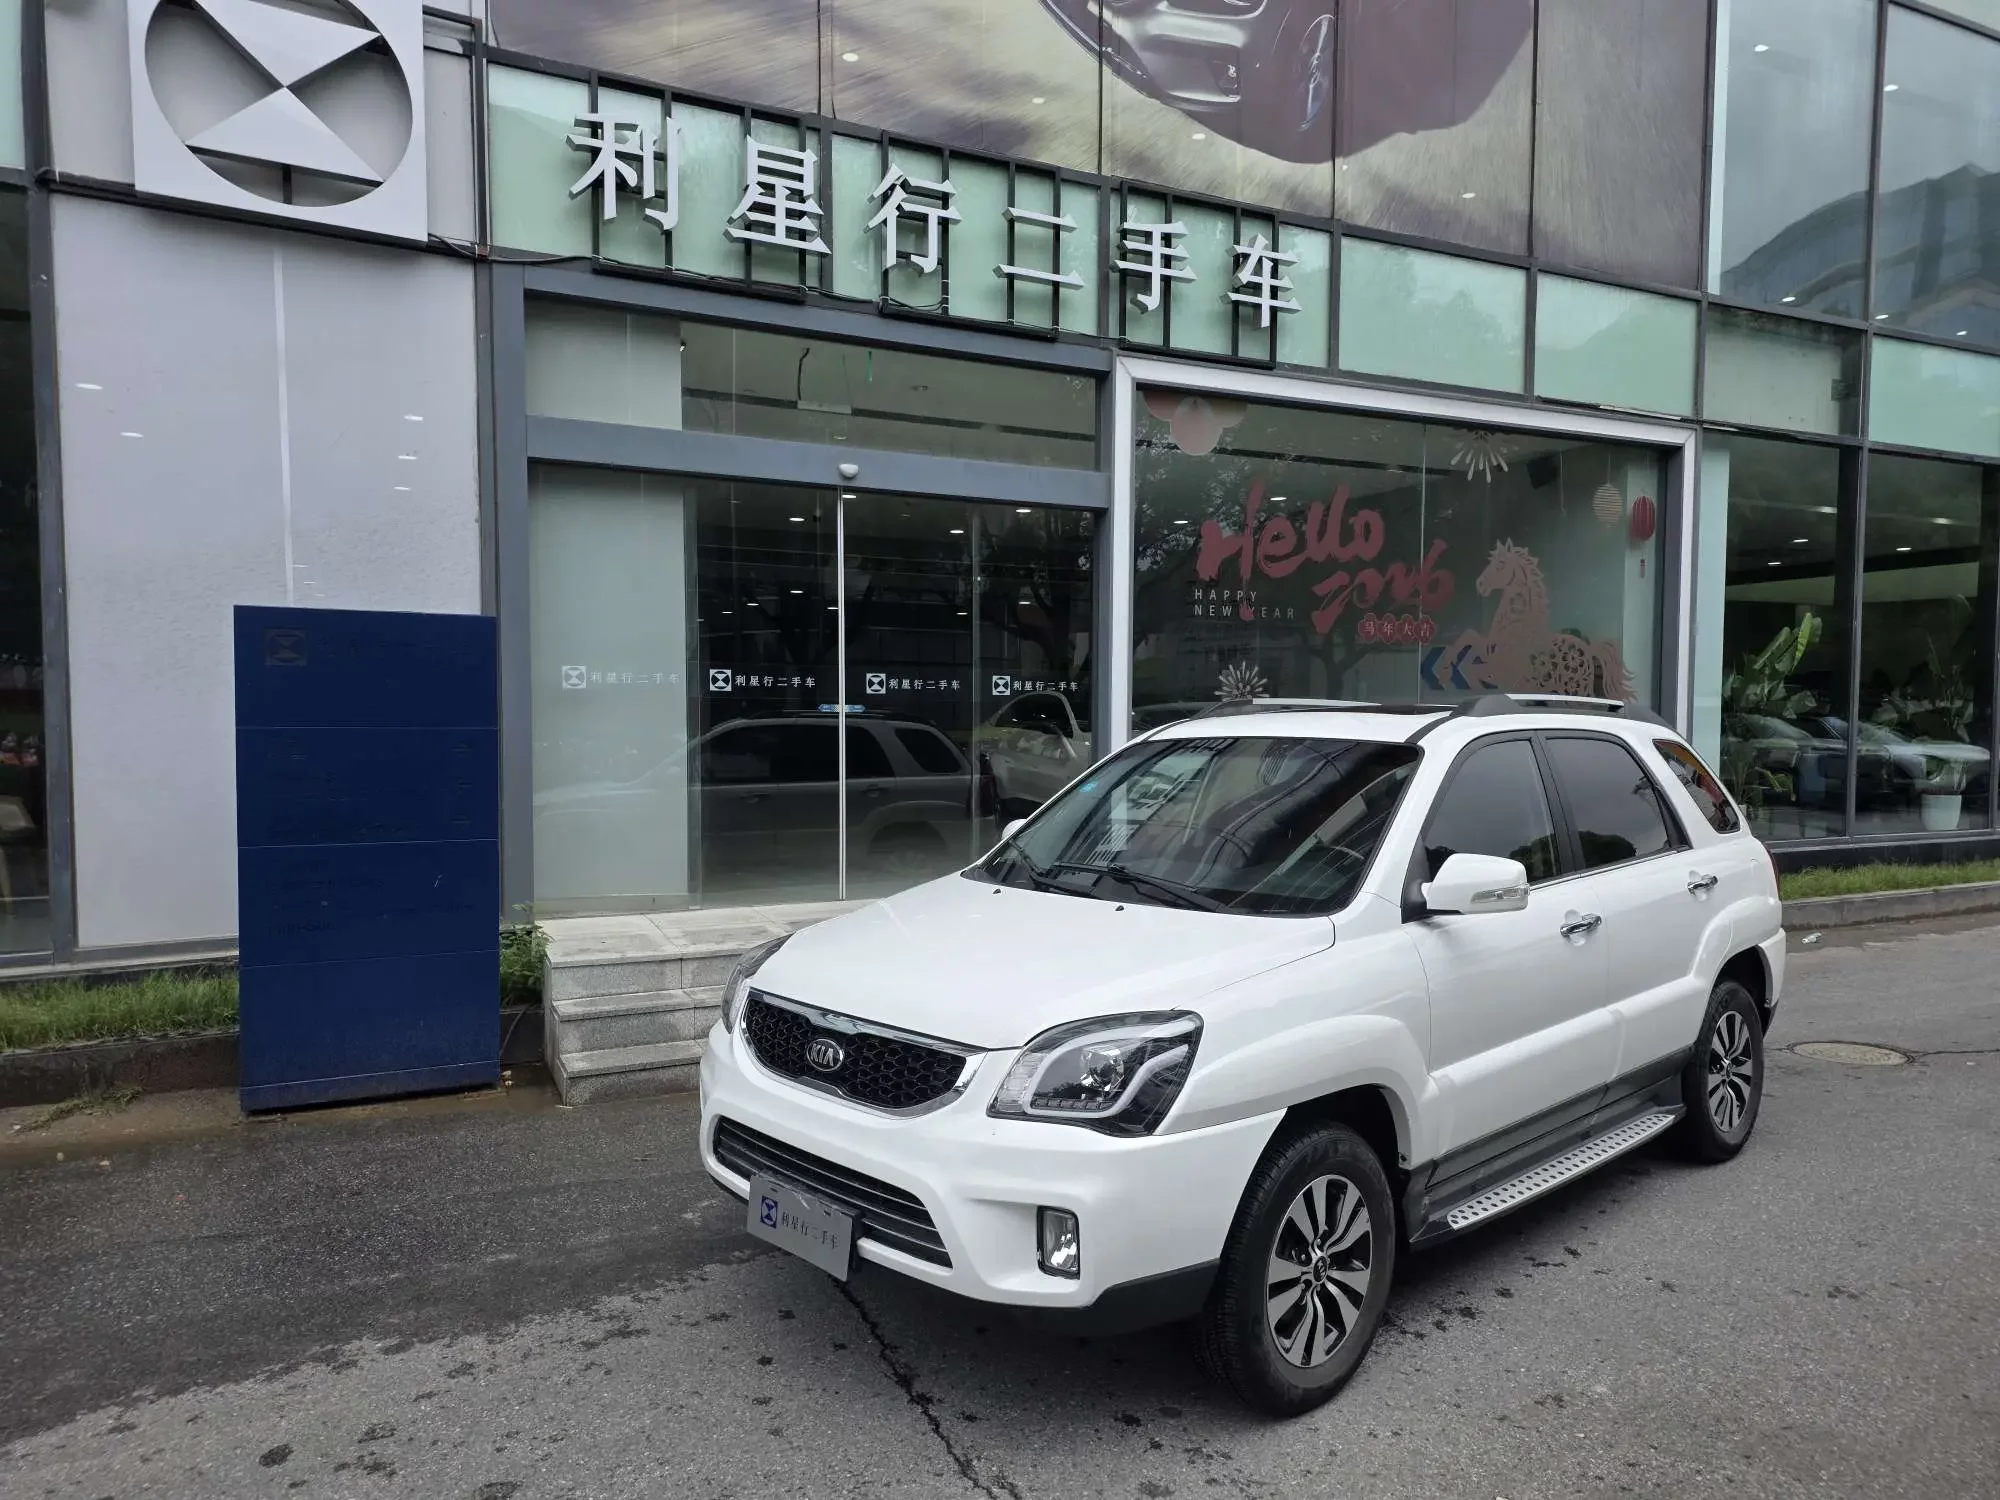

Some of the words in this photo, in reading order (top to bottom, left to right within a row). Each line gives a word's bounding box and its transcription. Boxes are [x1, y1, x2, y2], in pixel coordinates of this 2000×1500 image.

[565, 111, 1301, 329] 利星行二手车
[1196, 478, 1385, 583] Hello
[1194, 588, 1257, 602] HAPPY
[1194, 604, 1232, 617] NEW
[1248, 606, 1294, 619] YEAR
[1363, 621, 1430, 637] 马年大吉
[735, 674, 816, 688] 利星行二手车
[888, 678, 960, 691] 利星行二手车
[1013, 680, 1079, 692] 利星行二手车
[810, 1043, 834, 1067] KIA
